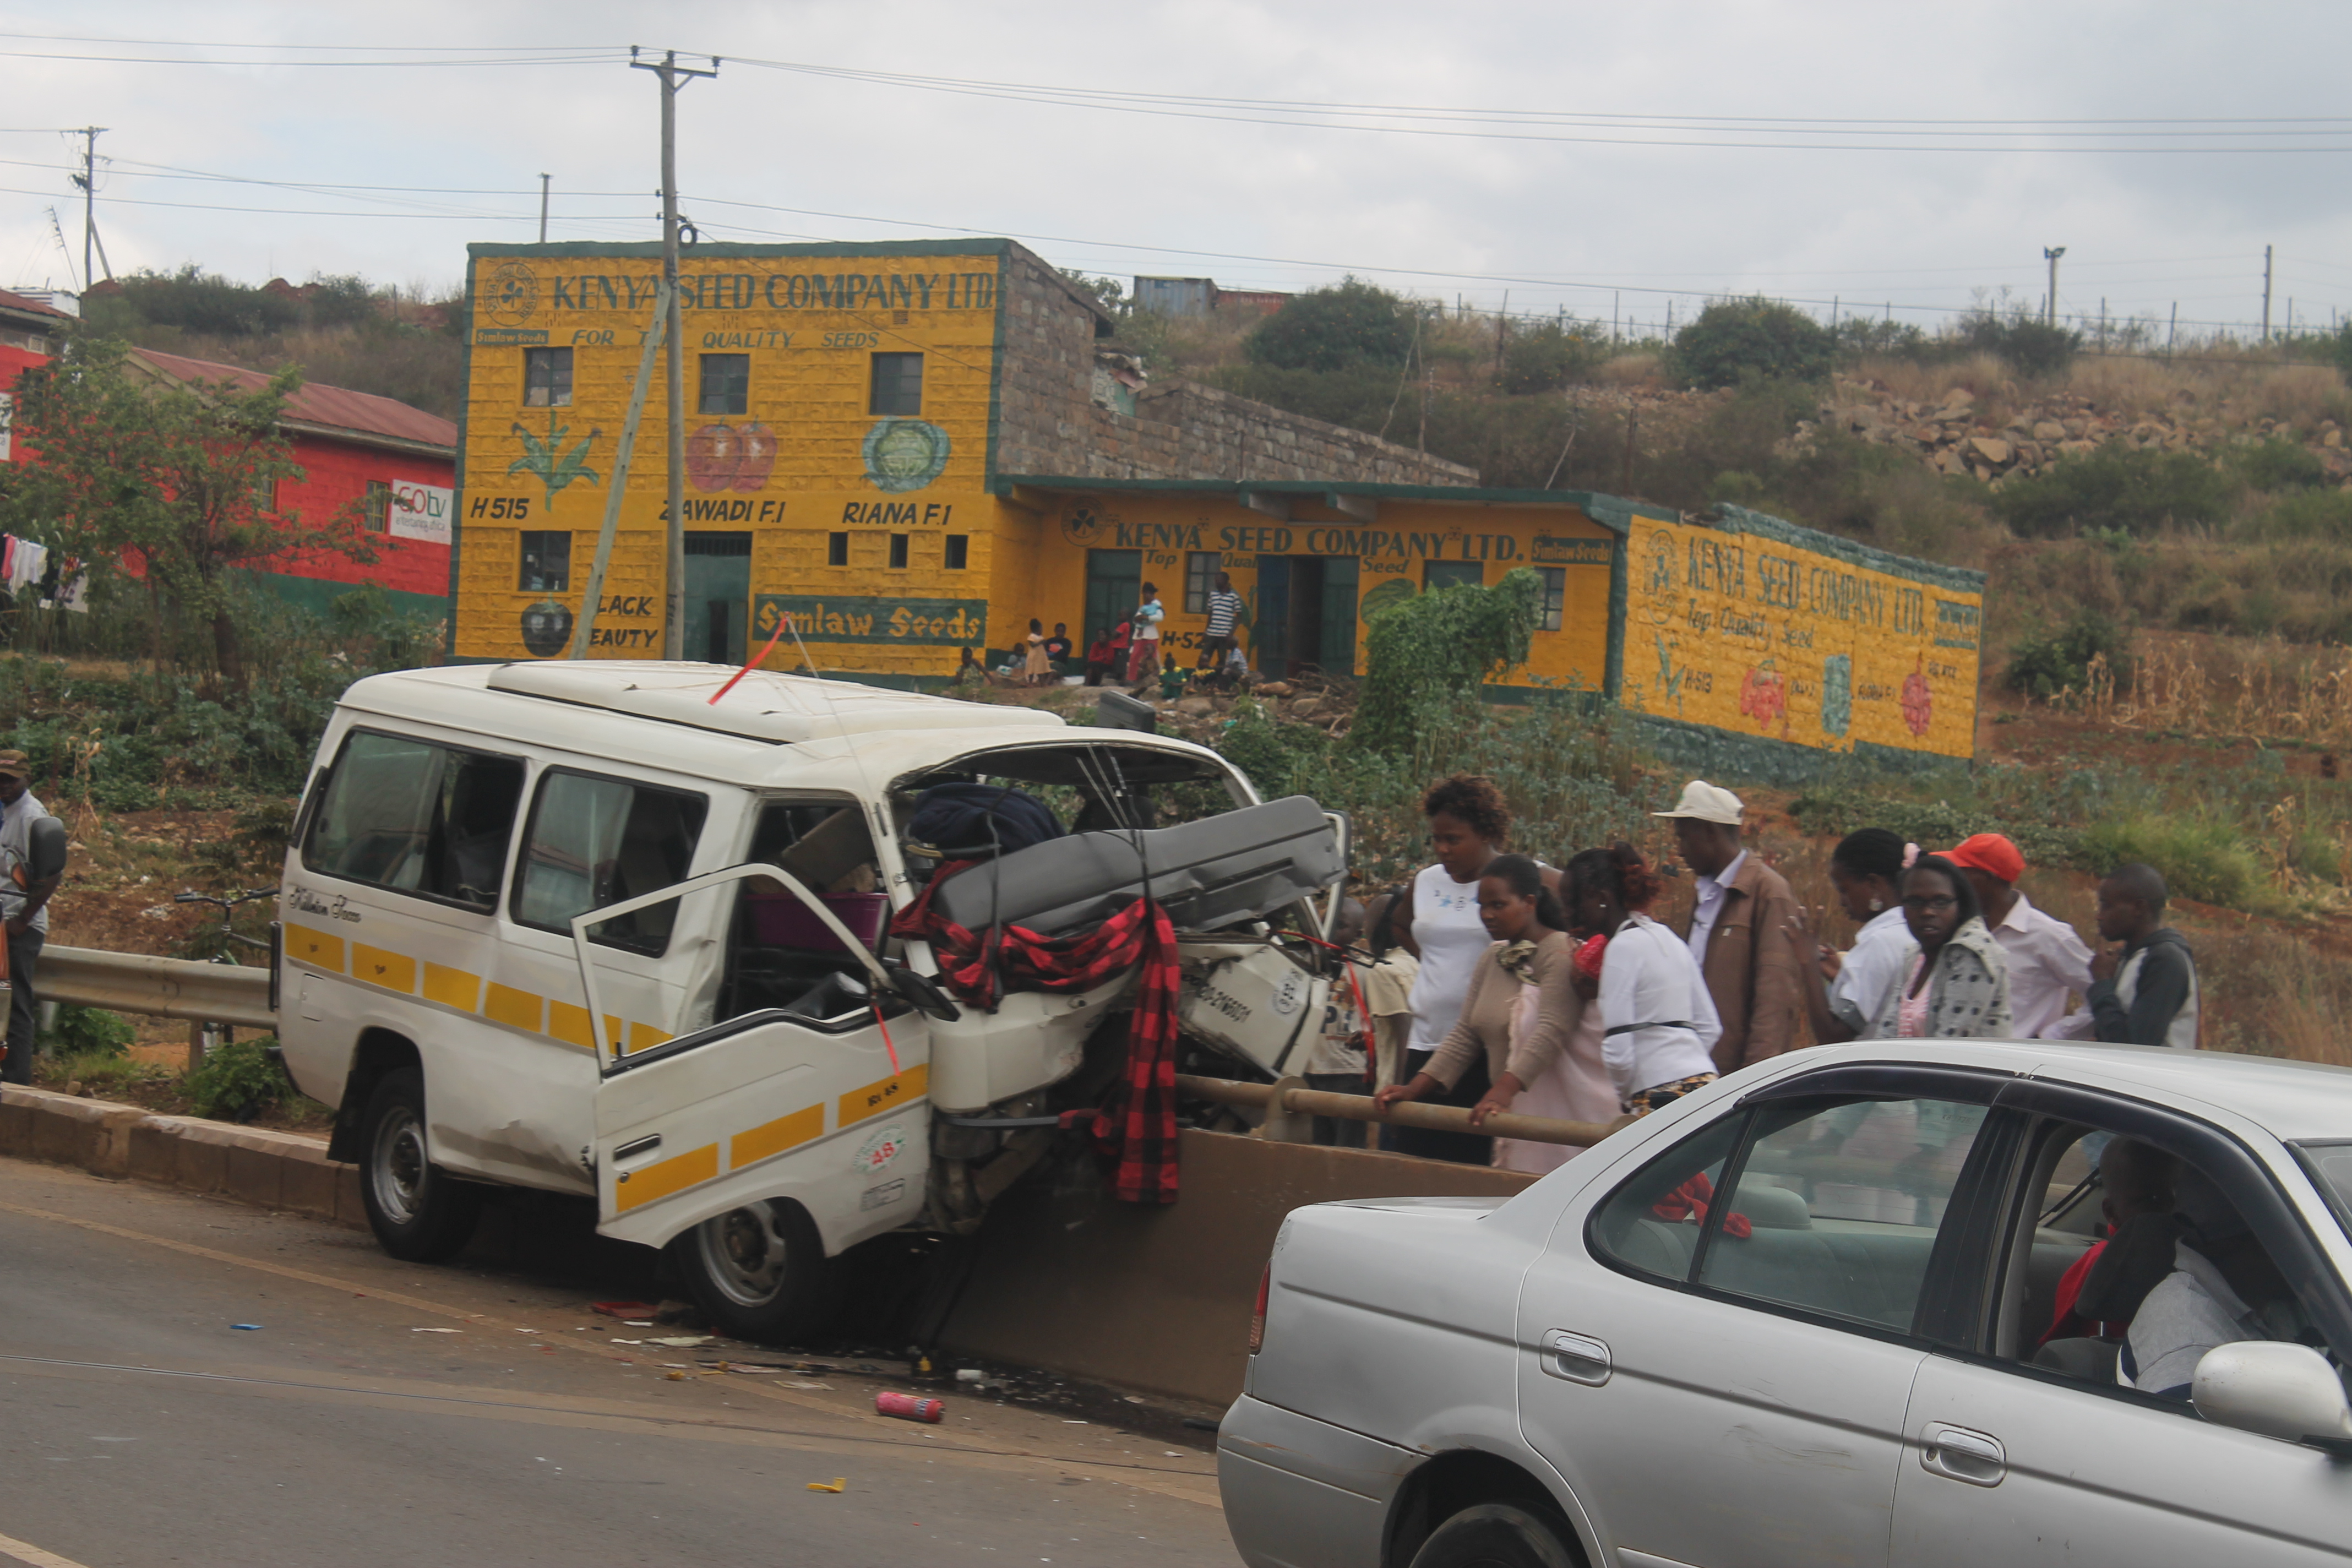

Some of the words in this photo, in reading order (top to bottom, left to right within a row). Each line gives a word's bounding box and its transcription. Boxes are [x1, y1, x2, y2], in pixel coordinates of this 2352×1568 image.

[553, 274, 662, 310] KENYA
[679, 274, 755, 309] SEED
[765, 273, 940, 309] COMPANY
[571, 329, 616, 345] FOR
[701, 331, 796, 349] QUALITY
[821, 331, 880, 349] SEEDS
[470, 497, 489, 519] H
[490, 498, 530, 520] 515
[842, 502, 917, 525] RIANA
[1115, 522, 1203, 549] KENYA
[1218, 525, 1294, 552] SEED
[1306, 527, 1448, 559] COMPANY
[1145, 549, 1177, 570] Top
[1362, 556, 1410, 574] Seed
[1687, 536, 1745, 600] KENYA
[1756, 553, 1801, 609] SEED
[1810, 567, 1888, 628] COMPANY
[597, 595, 653, 616] LACK
[888, 606, 981, 639] Seeds
[589, 628, 658, 647] EAUTY
